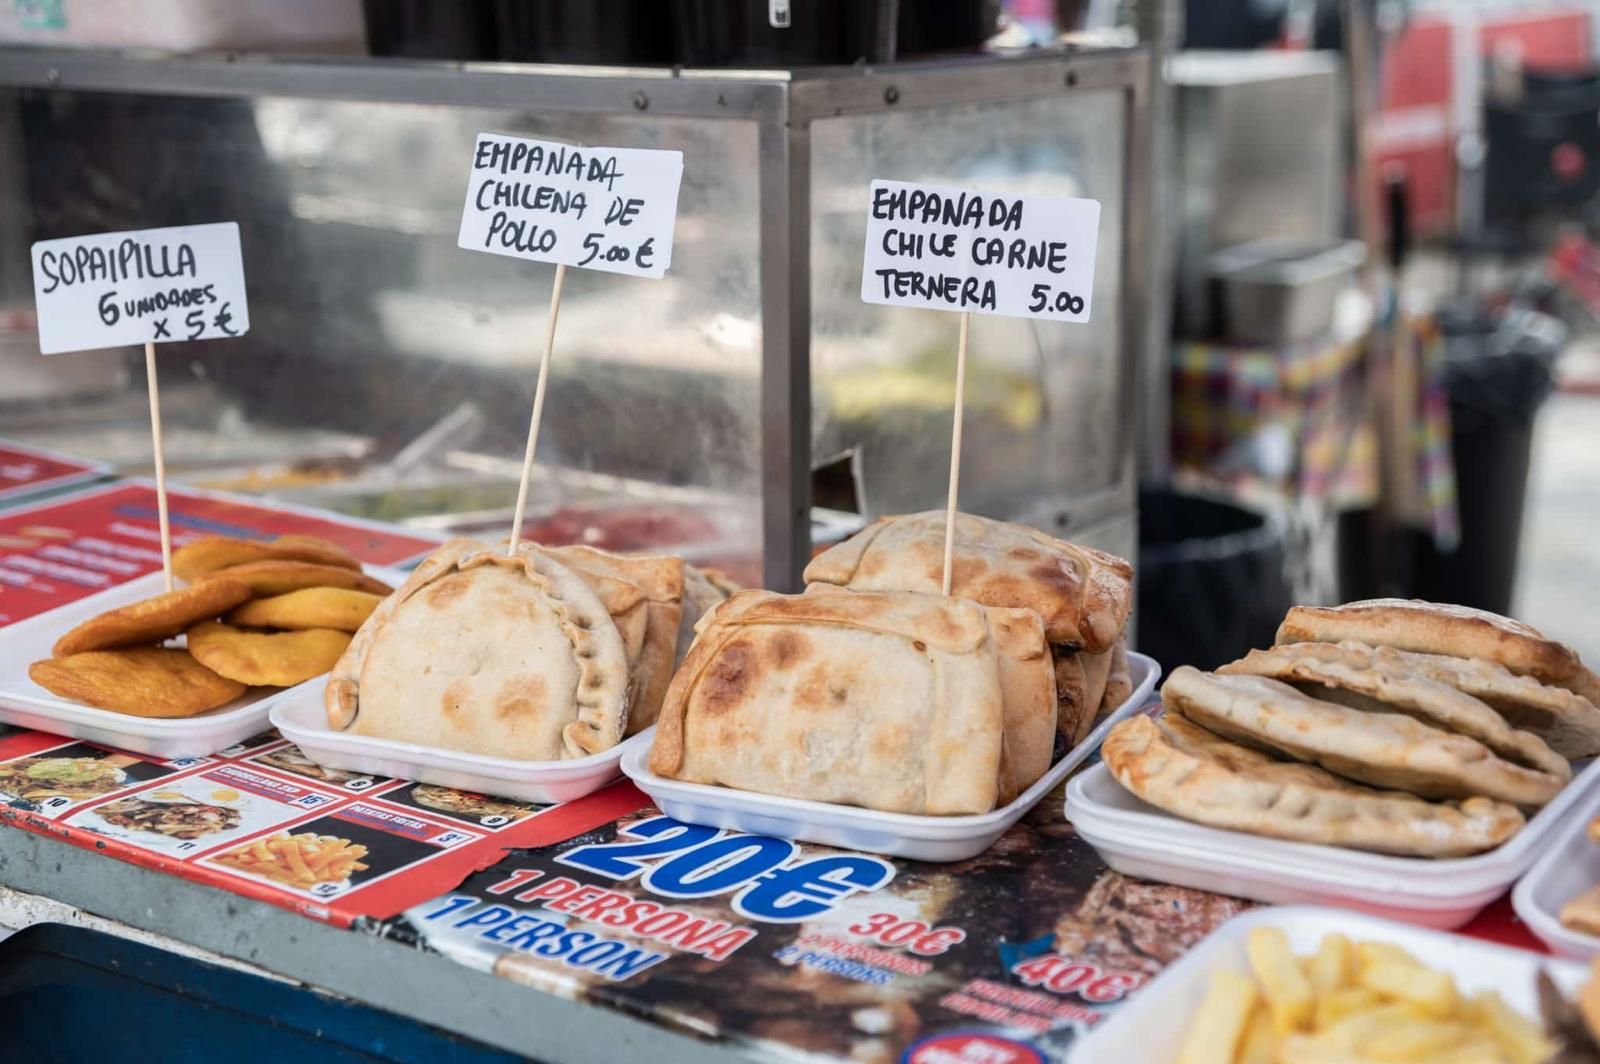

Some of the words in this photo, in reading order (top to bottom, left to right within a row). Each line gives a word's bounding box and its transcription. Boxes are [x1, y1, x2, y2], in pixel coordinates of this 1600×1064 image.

[474, 141, 624, 191] EMPANADA
[476, 179, 587, 220] CHILENA
[605, 196, 645, 226] DE
[872, 188, 1023, 231] EMPANADA
[485, 211, 557, 252] POLLO
[883, 229, 957, 259] CHILE
[972, 238, 1067, 273] CARNE
[41, 239, 196, 293] SOPAIPILLA
[98, 292, 120, 326] 6
[875, 269, 996, 310] TERNERA
[1029, 284, 1084, 314] 5.00
[47, 798, 68, 807] 10
[177, 842, 197, 850] 11
[556, 815, 894, 922] 20€
[487, 869, 545, 895] 1
[516, 874, 757, 961] PERSONA
[848, 913, 967, 956] 30€
[425, 897, 469, 921] 1
[457, 901, 669, 982] PERSON
[798, 951, 897, 985] PERSONS
[1013, 954, 1139, 1002] 40€
